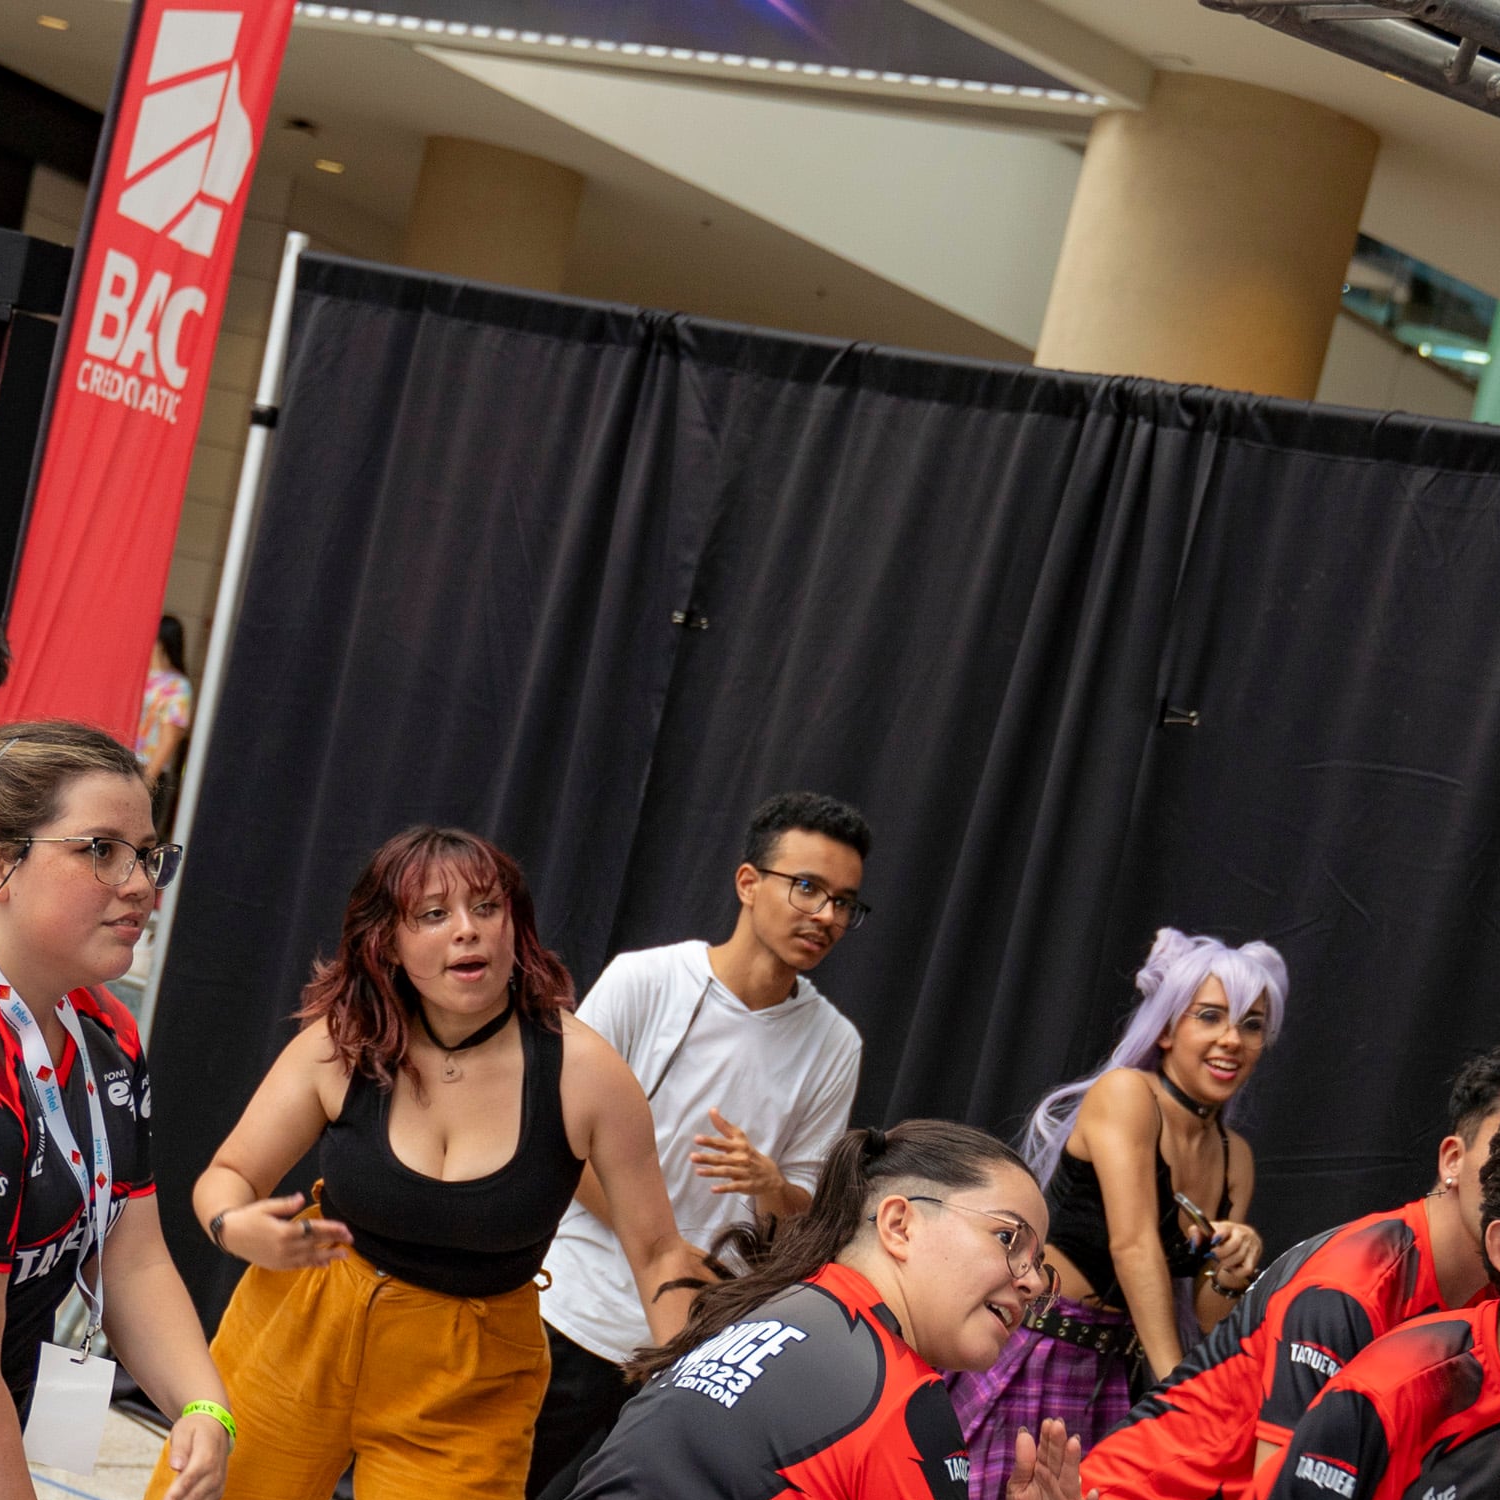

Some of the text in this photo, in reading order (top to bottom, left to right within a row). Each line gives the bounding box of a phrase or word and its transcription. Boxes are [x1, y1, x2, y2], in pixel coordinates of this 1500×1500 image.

[85, 248, 208, 390] BAC
[10, 1001, 31, 1028] intel
[43, 1086, 58, 1114] intel
[92, 1137, 104, 1165] intel
[674, 1376, 740, 1409] EDITION
